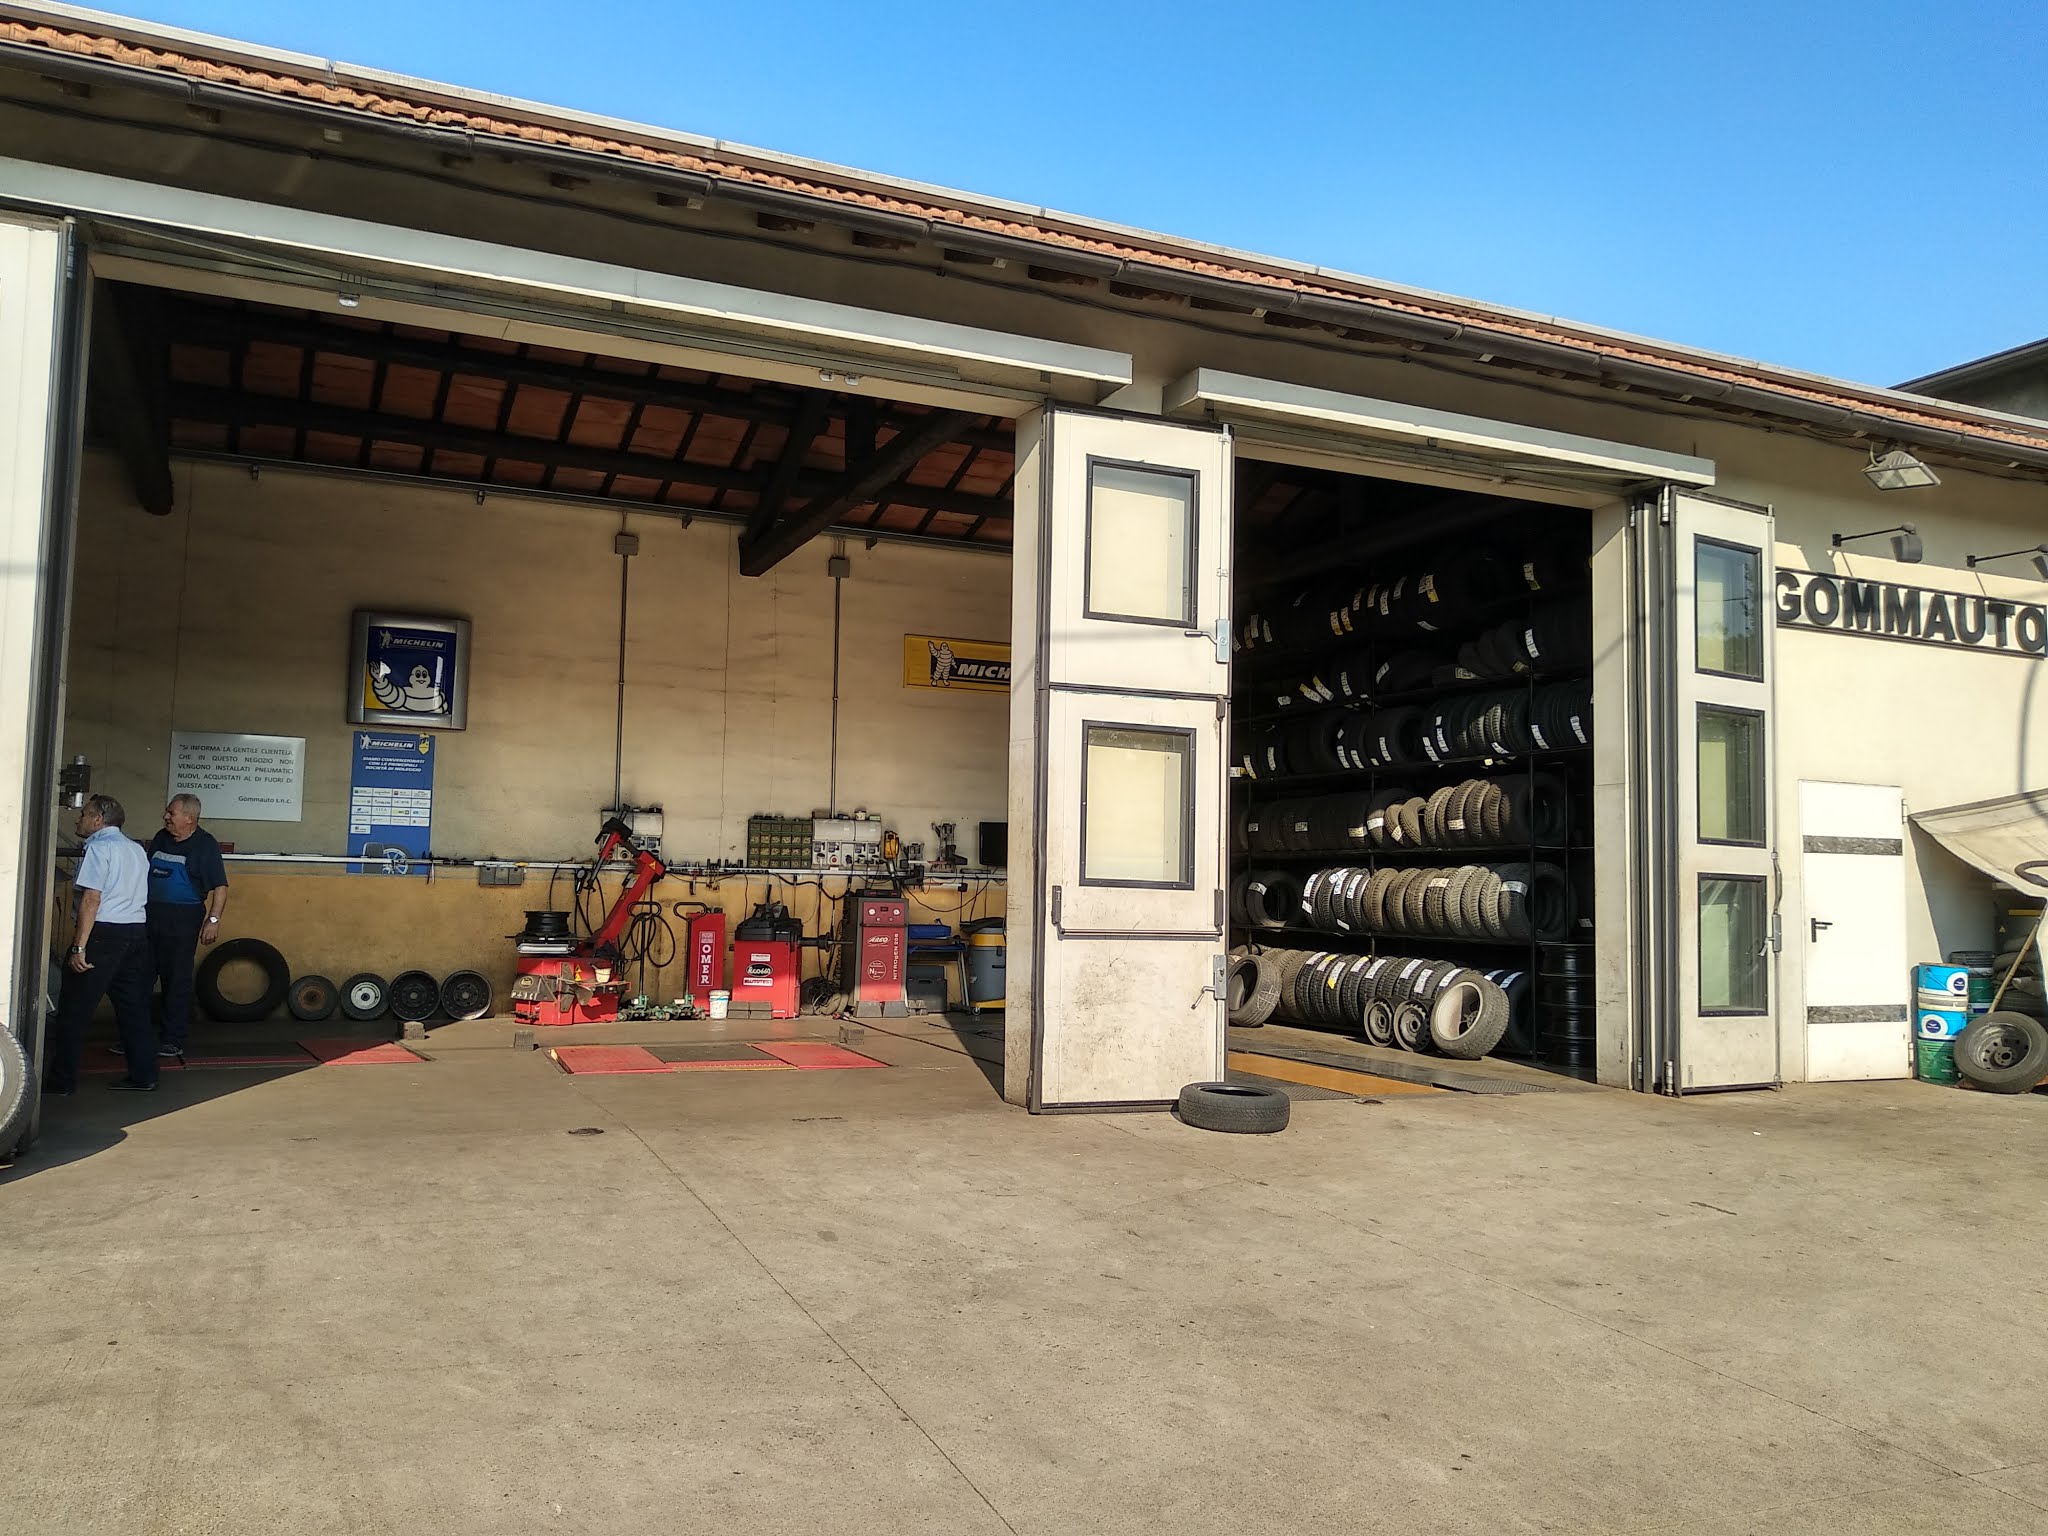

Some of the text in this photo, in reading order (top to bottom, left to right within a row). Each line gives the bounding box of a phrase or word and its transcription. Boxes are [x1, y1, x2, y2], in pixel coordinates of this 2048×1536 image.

[1776, 571, 2046, 652] GOMMAUTO
[393, 639, 444, 648] MICHELIN
[700, 944, 712, 984] OMER
